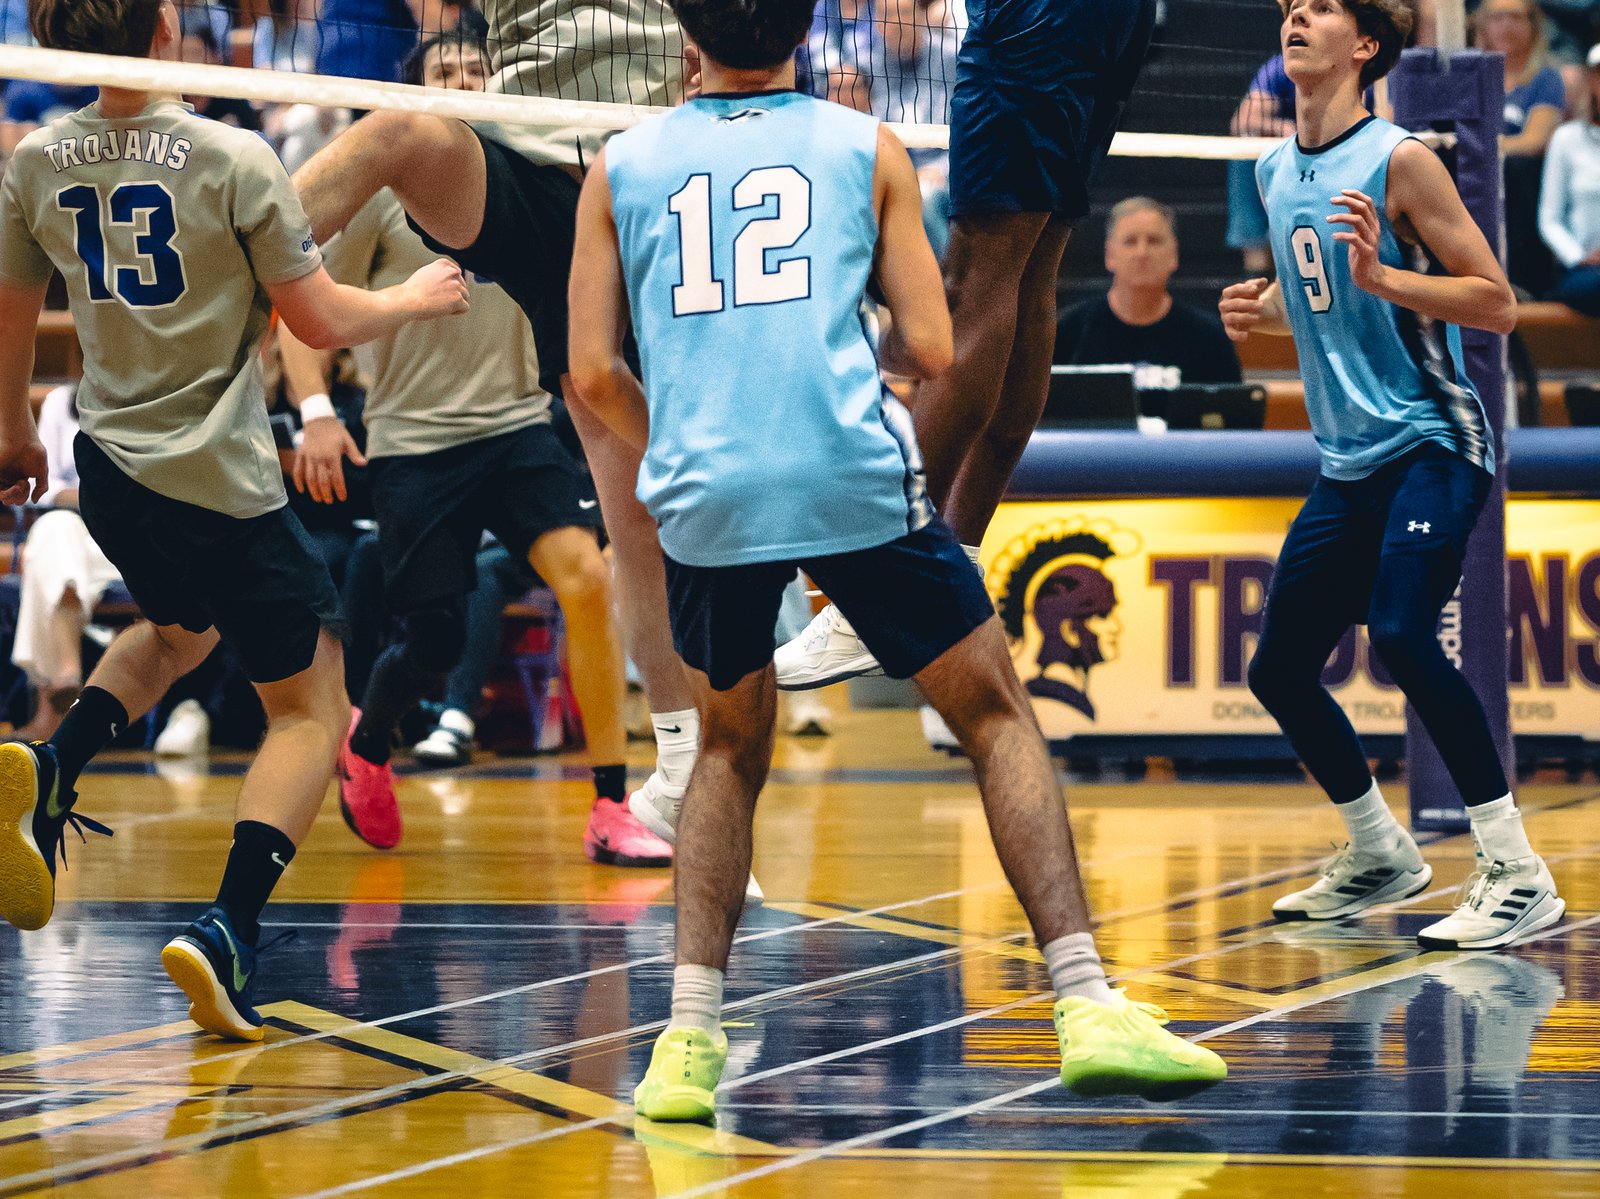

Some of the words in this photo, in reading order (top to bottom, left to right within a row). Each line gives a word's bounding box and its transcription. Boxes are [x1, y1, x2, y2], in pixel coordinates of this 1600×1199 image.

[43, 128, 193, 174] TROJANS
[56, 180, 189, 311] 13
[668, 164, 812, 318] 12
[1290, 225, 1334, 314] 9
